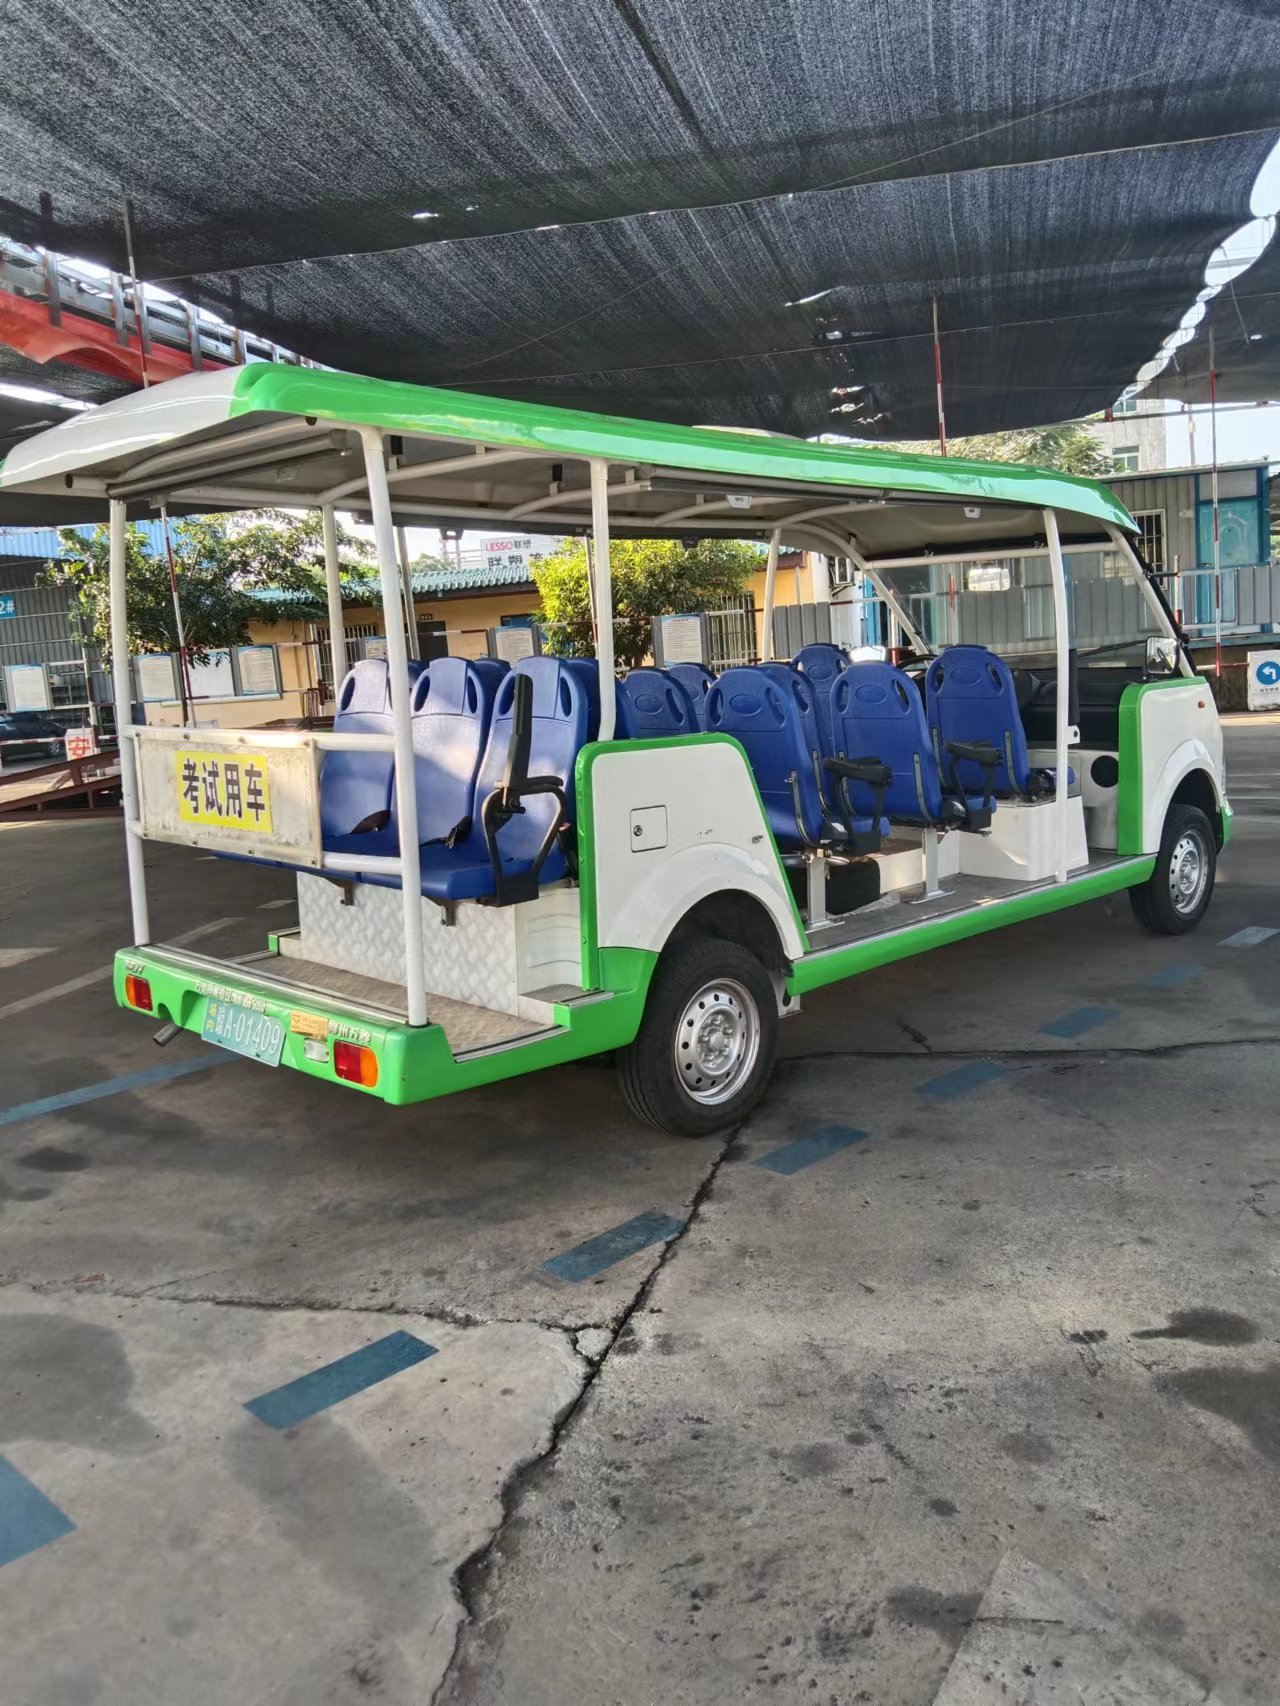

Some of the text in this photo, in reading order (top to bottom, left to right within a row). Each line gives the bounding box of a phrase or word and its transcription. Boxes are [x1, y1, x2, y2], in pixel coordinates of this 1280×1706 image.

[485, 541, 513, 551] LESSO
[68, 737, 91, 759] 安
[182, 757, 265, 821] 考试用车
